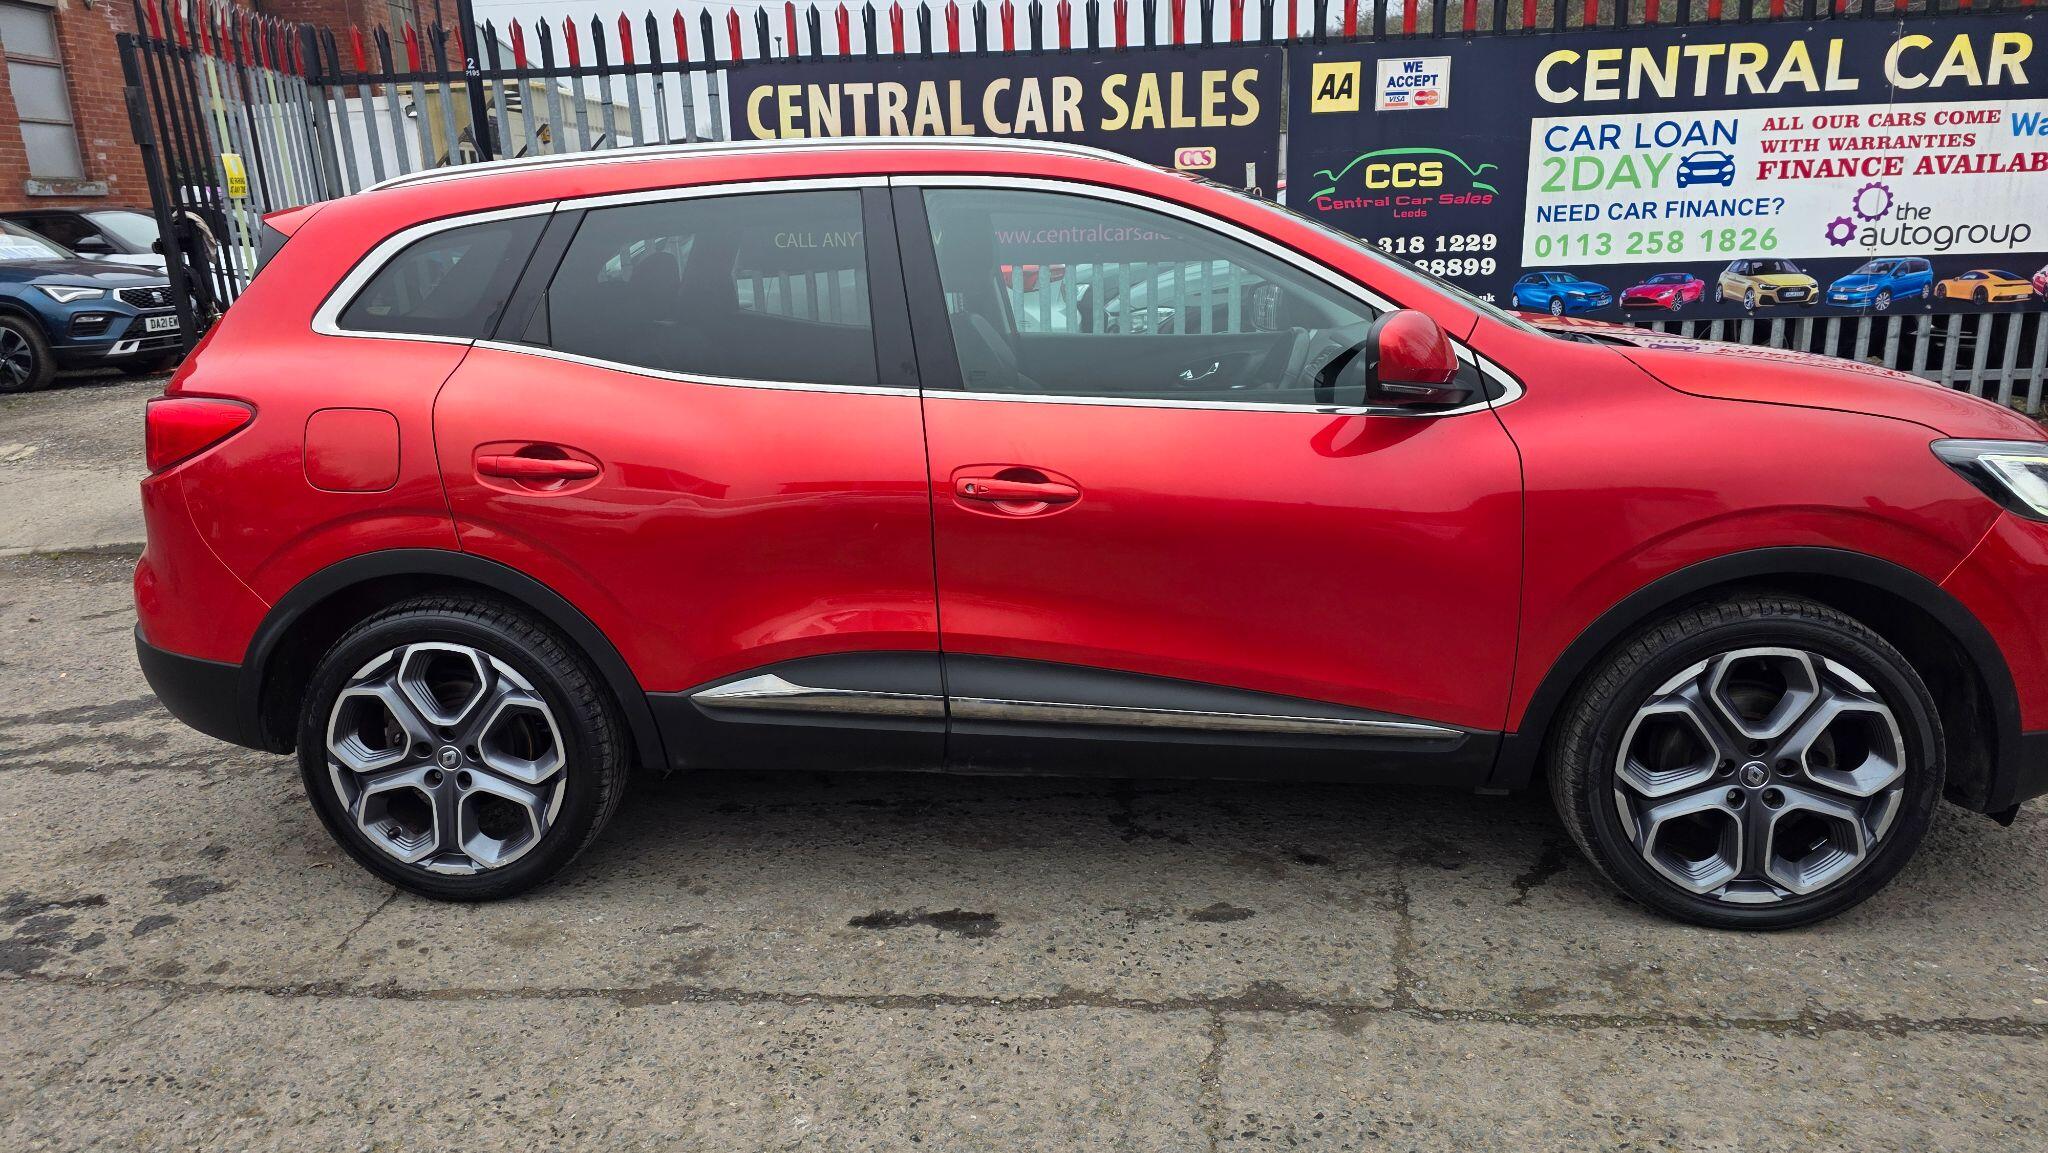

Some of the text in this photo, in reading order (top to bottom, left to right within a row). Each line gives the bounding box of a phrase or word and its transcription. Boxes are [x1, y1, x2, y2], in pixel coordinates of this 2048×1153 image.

[1403, 61, 1424, 74] WE
[1534, 31, 2034, 104] CENTRAL CAR
[1317, 72, 1353, 100] AA
[1386, 74, 1439, 89] ACCEPT
[746, 68, 1261, 140] CENTRAL CAR SALES
[1389, 95, 1406, 103] VISA
[1761, 109, 2002, 132] ALL OUR CARS COME
[1544, 118, 1739, 152] CAR LOAN
[1760, 133, 1977, 154] WITH WARRANTIES
[1365, 161, 1443, 189] CCS
[1540, 152, 1674, 193] 2DAY
[1756, 151, 2048, 181] FINANCE AVAILAB
[1316, 192, 1493, 212] Central Car Sales
[1393, 208, 1428, 218] Leeds
[1536, 197, 1785, 223] NEED CAR FINANCE?
[1896, 202, 1932, 221] the
[775, 231, 818, 248] CALL
[1378, 233, 1498, 253] 318 1229
[1534, 227, 1778, 258] 0113 258 1826
[1859, 222, 2032, 252] autogroup
